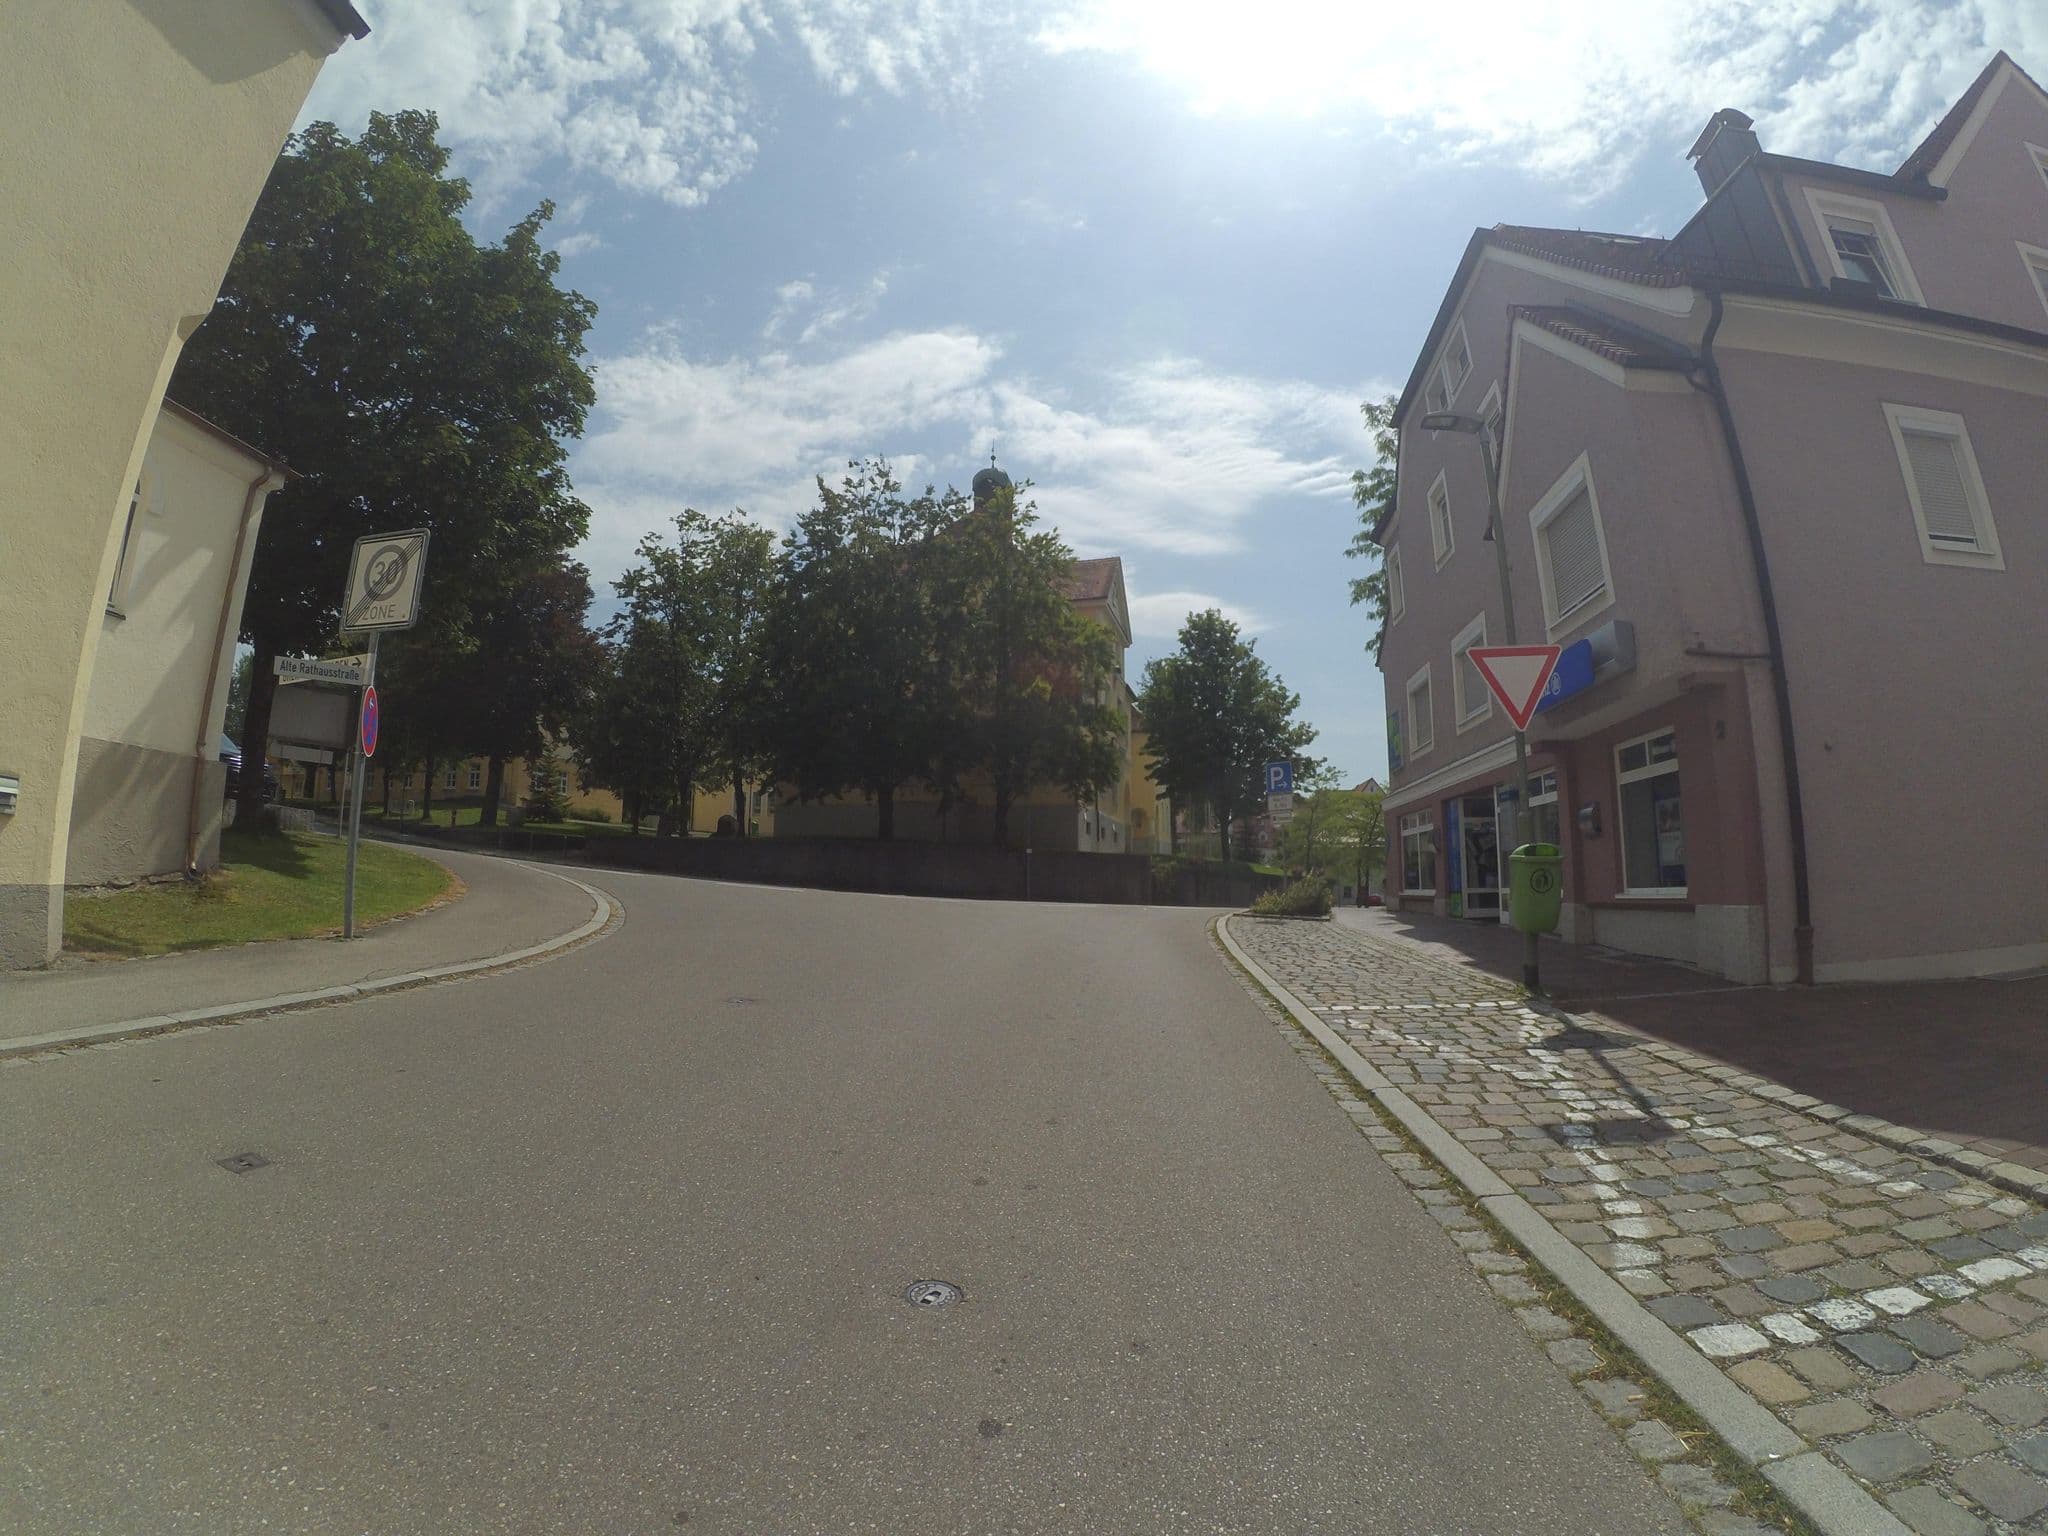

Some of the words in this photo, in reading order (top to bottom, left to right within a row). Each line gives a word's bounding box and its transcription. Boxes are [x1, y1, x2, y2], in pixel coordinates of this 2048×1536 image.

[372, 559, 398, 585] 30
[362, 604, 397, 621] ZONE
[279, 659, 298, 673] Alte
[299, 663, 361, 681] Rathausstraße
[1270, 766, 1284, 790] P
